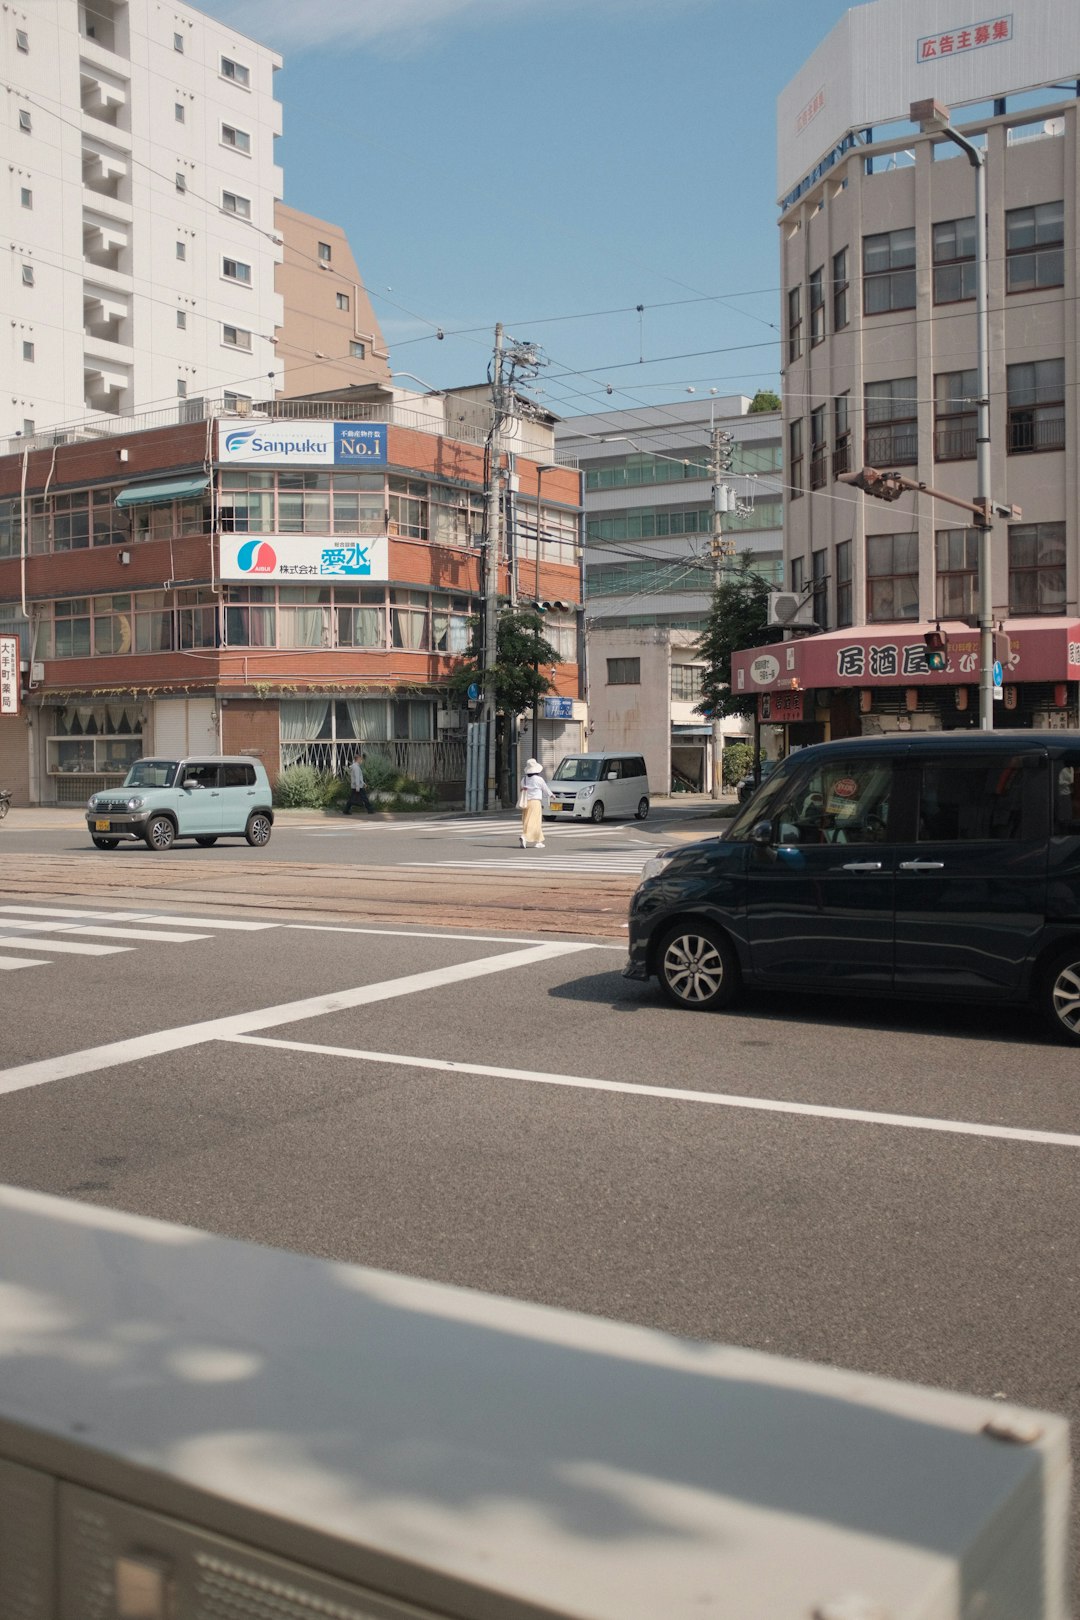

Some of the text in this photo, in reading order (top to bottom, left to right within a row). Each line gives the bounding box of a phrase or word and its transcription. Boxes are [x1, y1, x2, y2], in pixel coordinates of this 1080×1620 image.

[921, 20, 1009, 59] 広告主募集
[252, 438, 327, 456] Sanpuku
[340, 438, 381, 455] No.1
[279, 564, 318, 575] 株式会社
[320, 543, 371, 575] 愛水
[1, 642, 11, 708] 大手町薬局
[837, 644, 931, 677] 居酒屋
